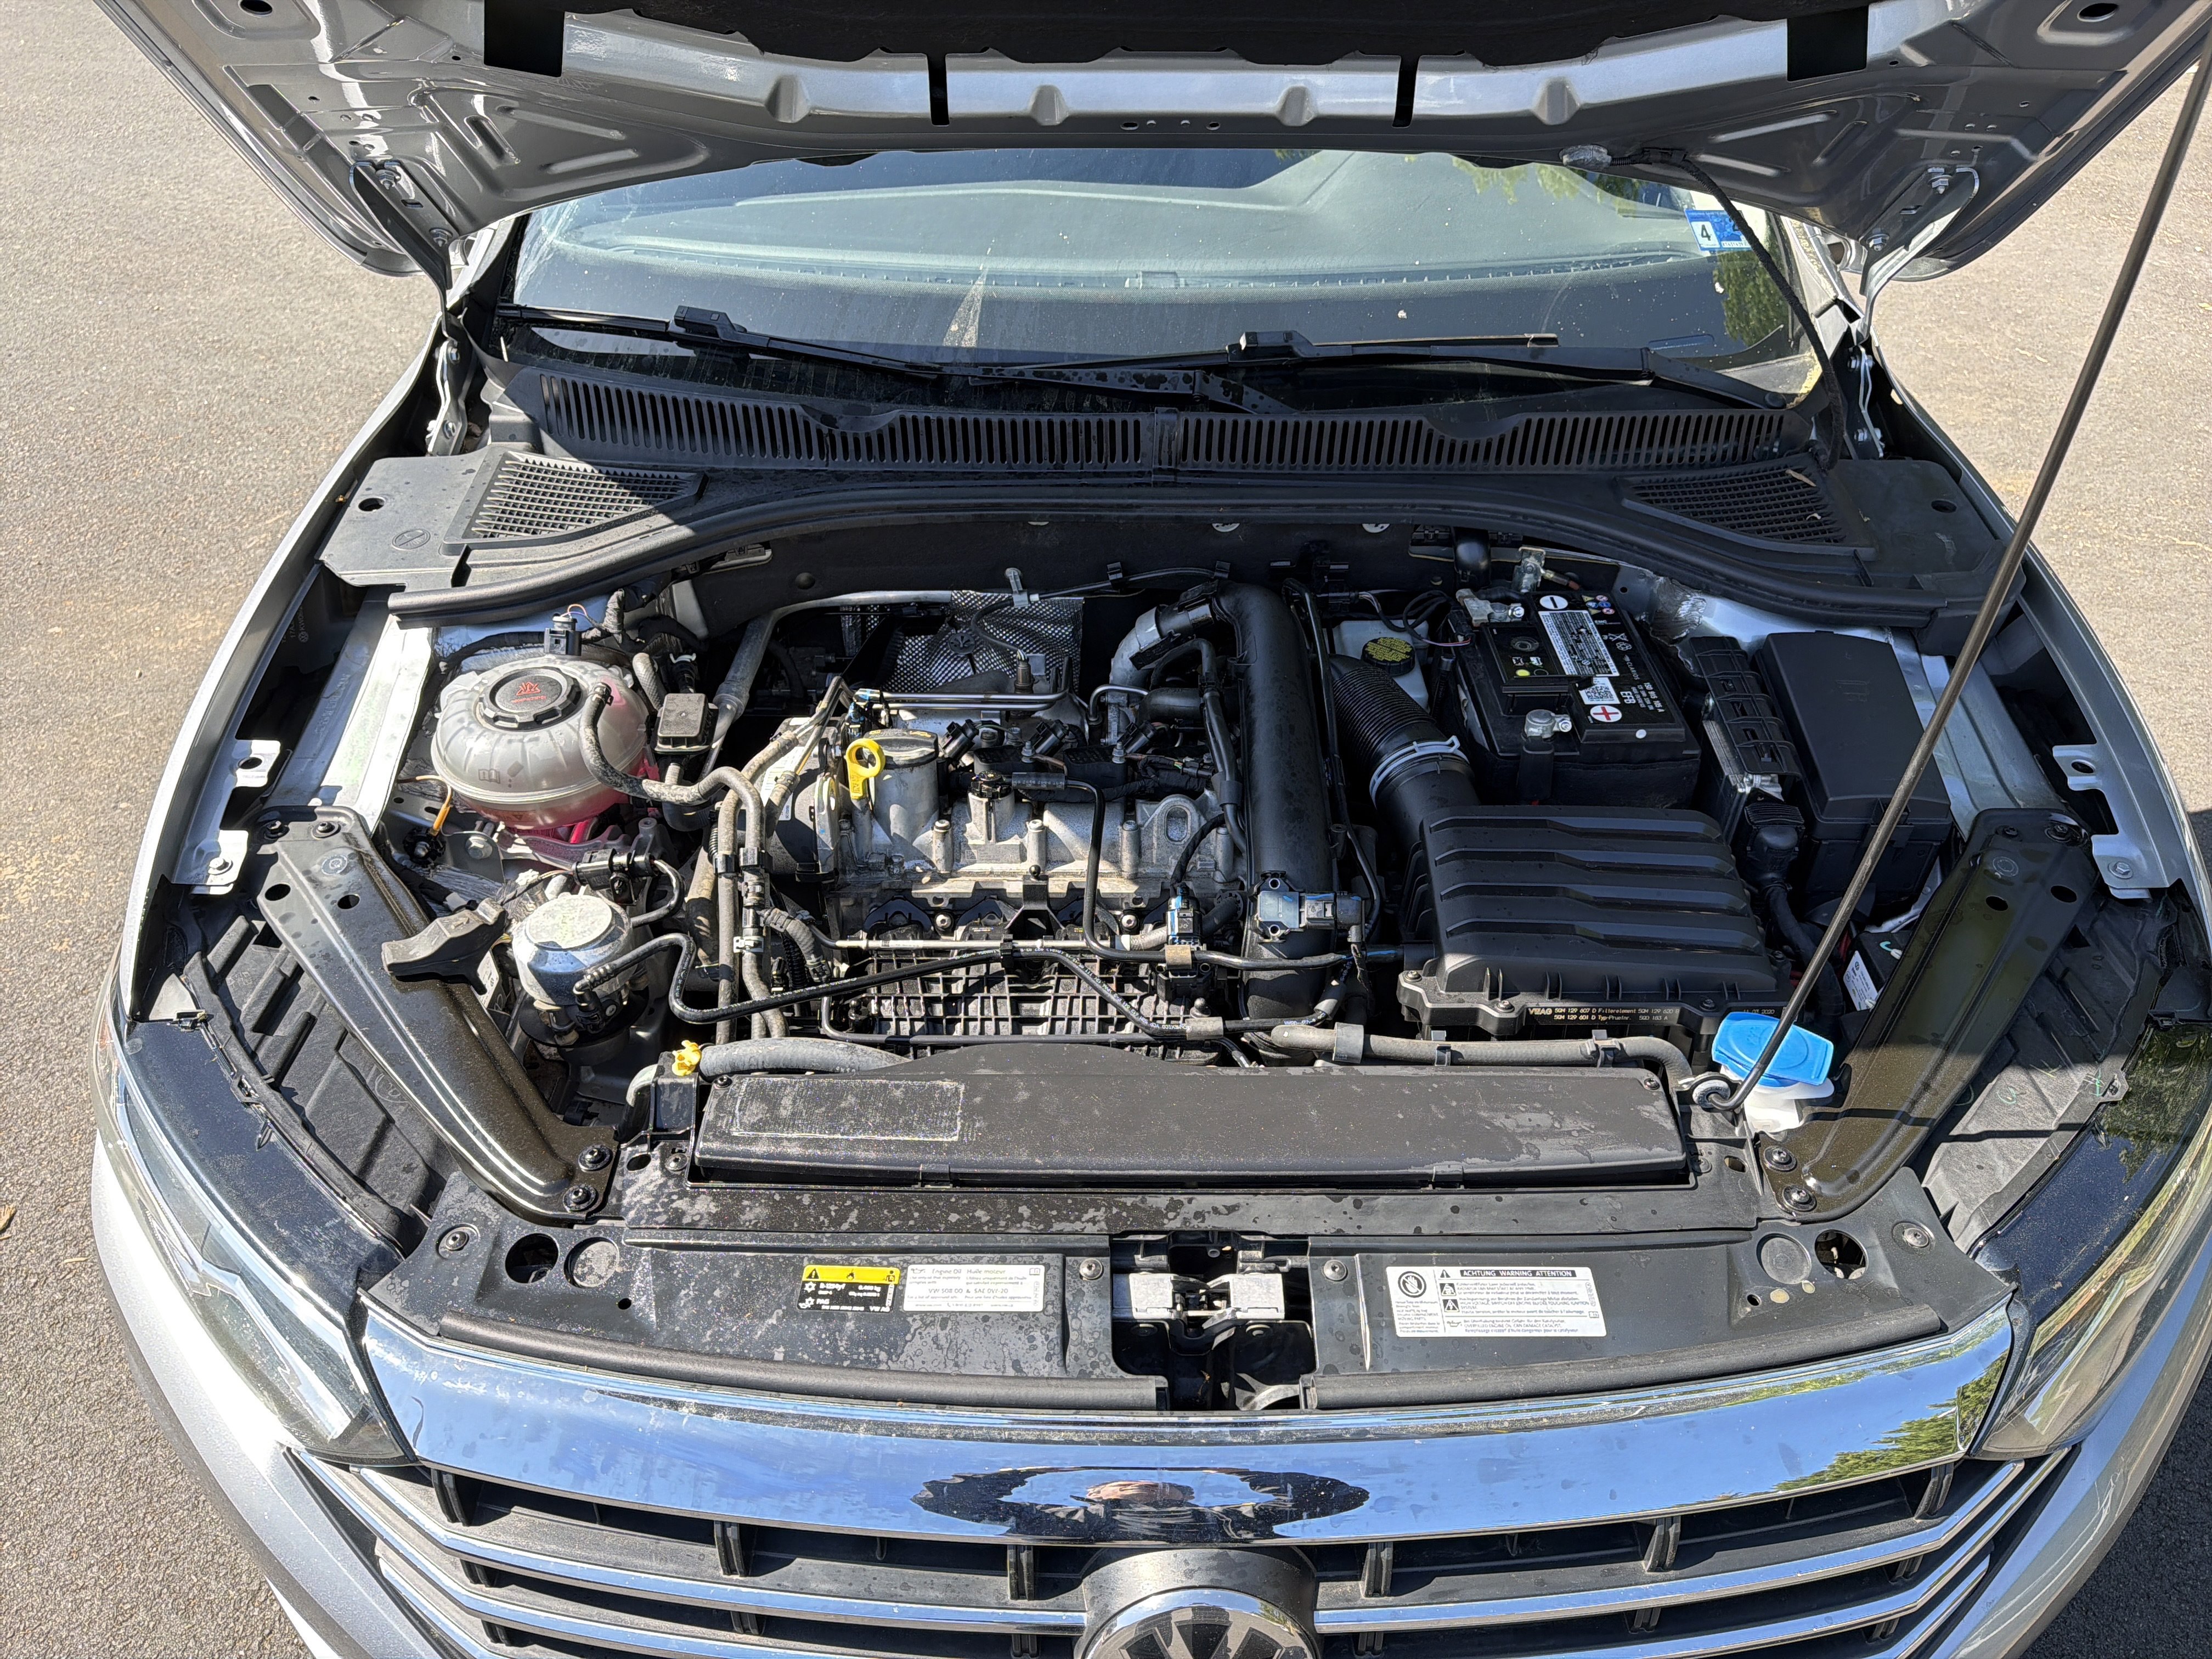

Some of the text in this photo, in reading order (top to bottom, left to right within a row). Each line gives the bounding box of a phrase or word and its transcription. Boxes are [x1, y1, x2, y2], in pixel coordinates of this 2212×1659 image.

[1701, 224, 1711, 241] 4
[1627, 662, 1640, 680] CLARIOS
[1620, 691, 1637, 704] EFB
